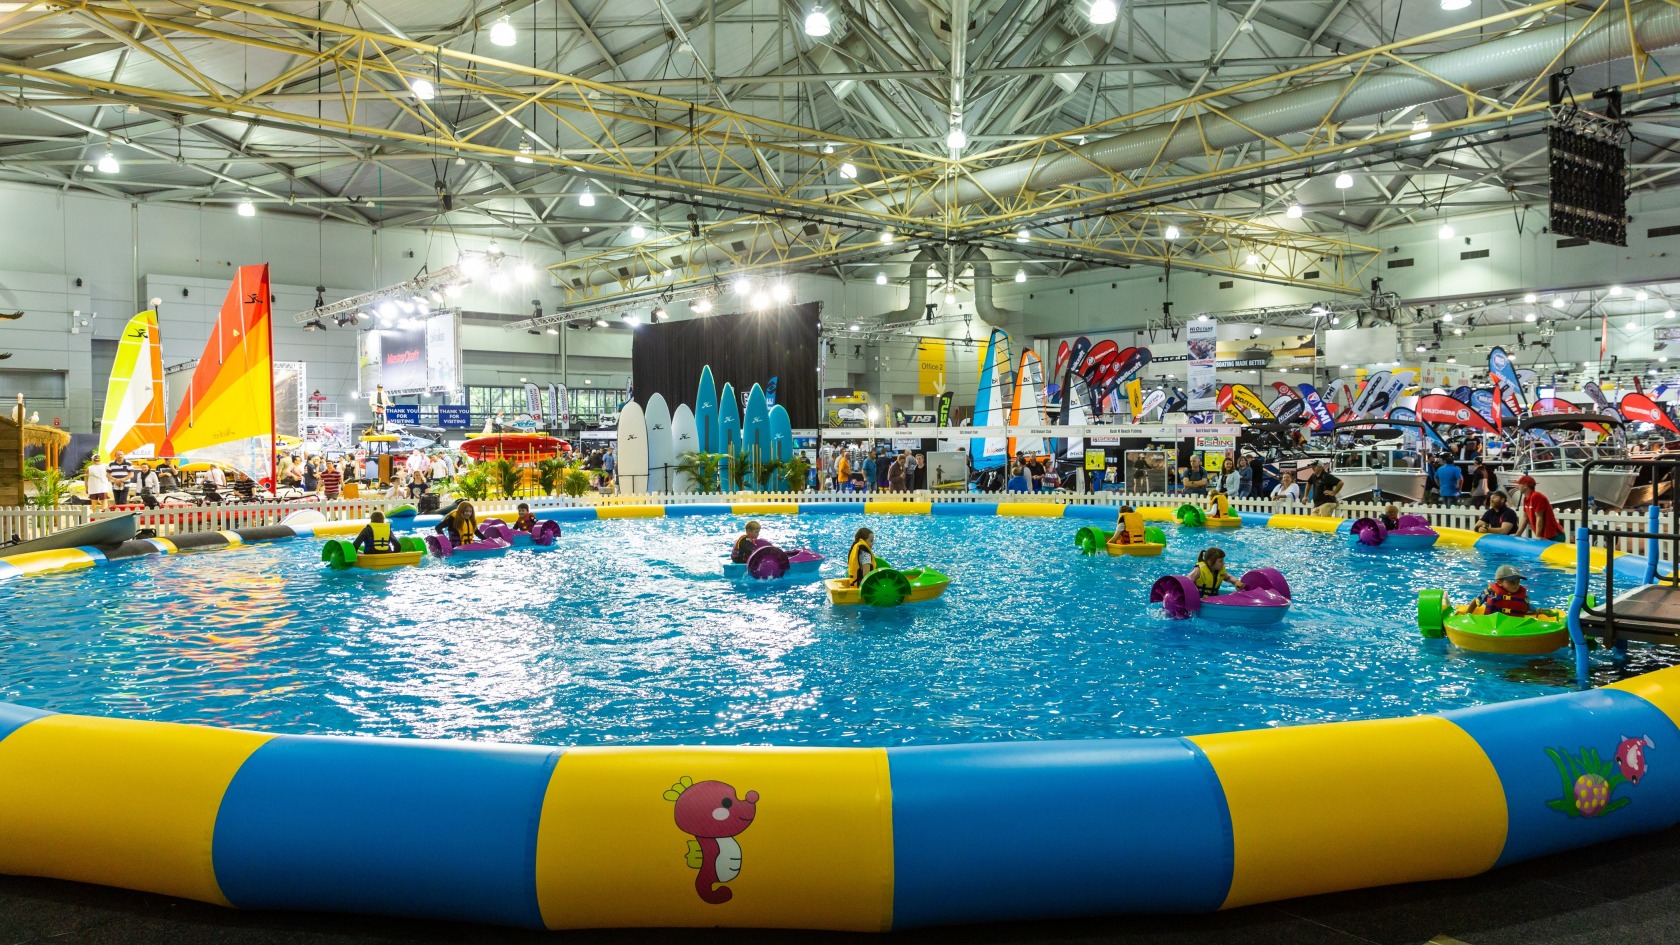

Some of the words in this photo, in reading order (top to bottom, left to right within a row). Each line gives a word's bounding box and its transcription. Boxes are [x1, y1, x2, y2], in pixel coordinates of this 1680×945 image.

[921, 362, 938, 370] Office
[1115, 361, 1142, 384] Wellcraft
[1323, 386, 1336, 400] YMI
[1315, 402, 1332, 425] YMI
